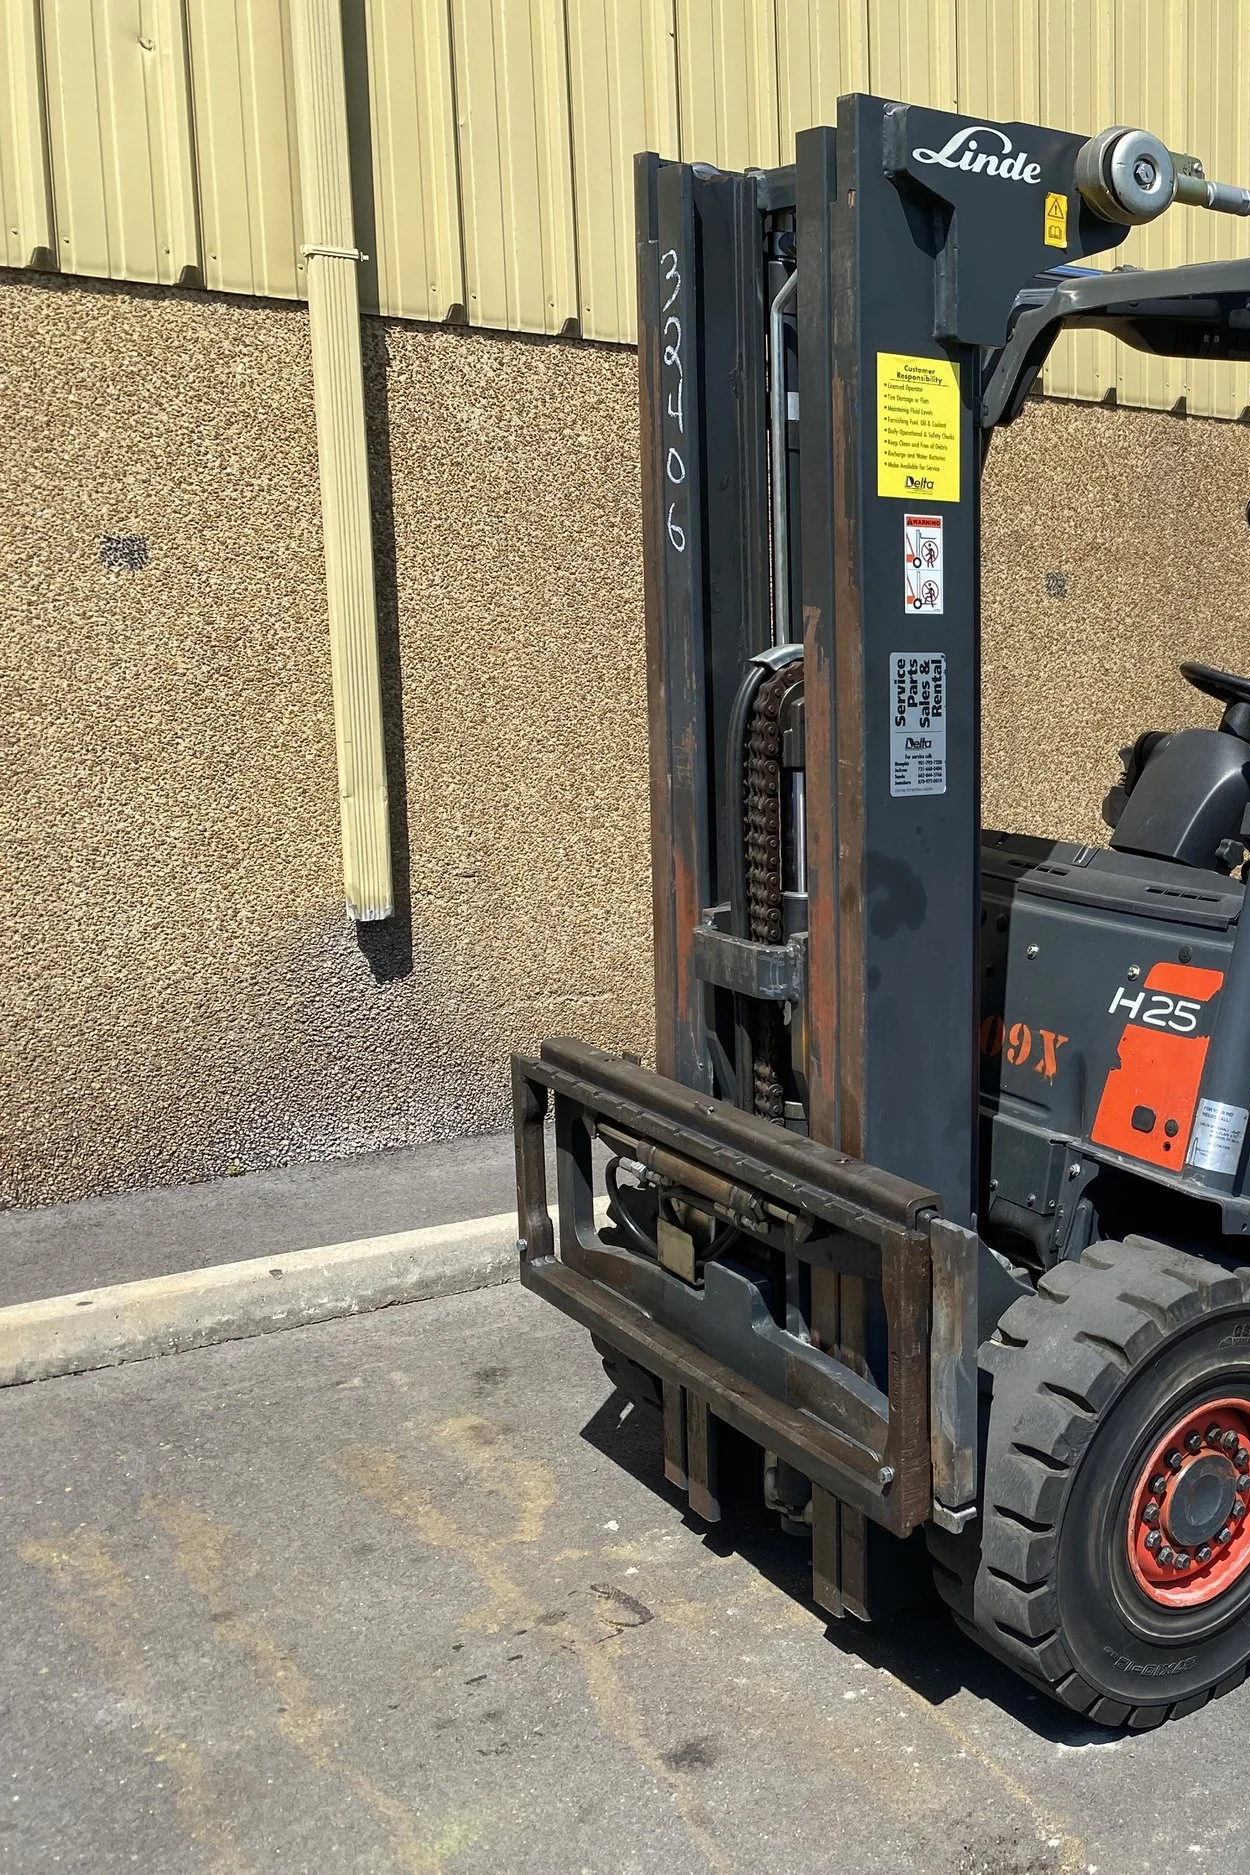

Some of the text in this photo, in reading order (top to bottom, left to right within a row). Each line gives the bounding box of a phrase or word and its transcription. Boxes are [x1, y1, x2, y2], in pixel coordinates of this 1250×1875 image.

[912, 126, 1041, 184] Linde
[896, 371, 943, 386] Responsibility
[904, 364, 935, 374] Customer
[661, 249, 685, 551] 32406
[905, 475, 934, 489] Delta
[912, 519, 940, 527] WARNING
[894, 658, 906, 727] Service
[907, 658, 918, 708] Parts
[919, 659, 930, 728] Sales &
[931, 659, 942, 718] Rental
[905, 737, 932, 750] Delta
[1108, 986, 1201, 1032] H25
